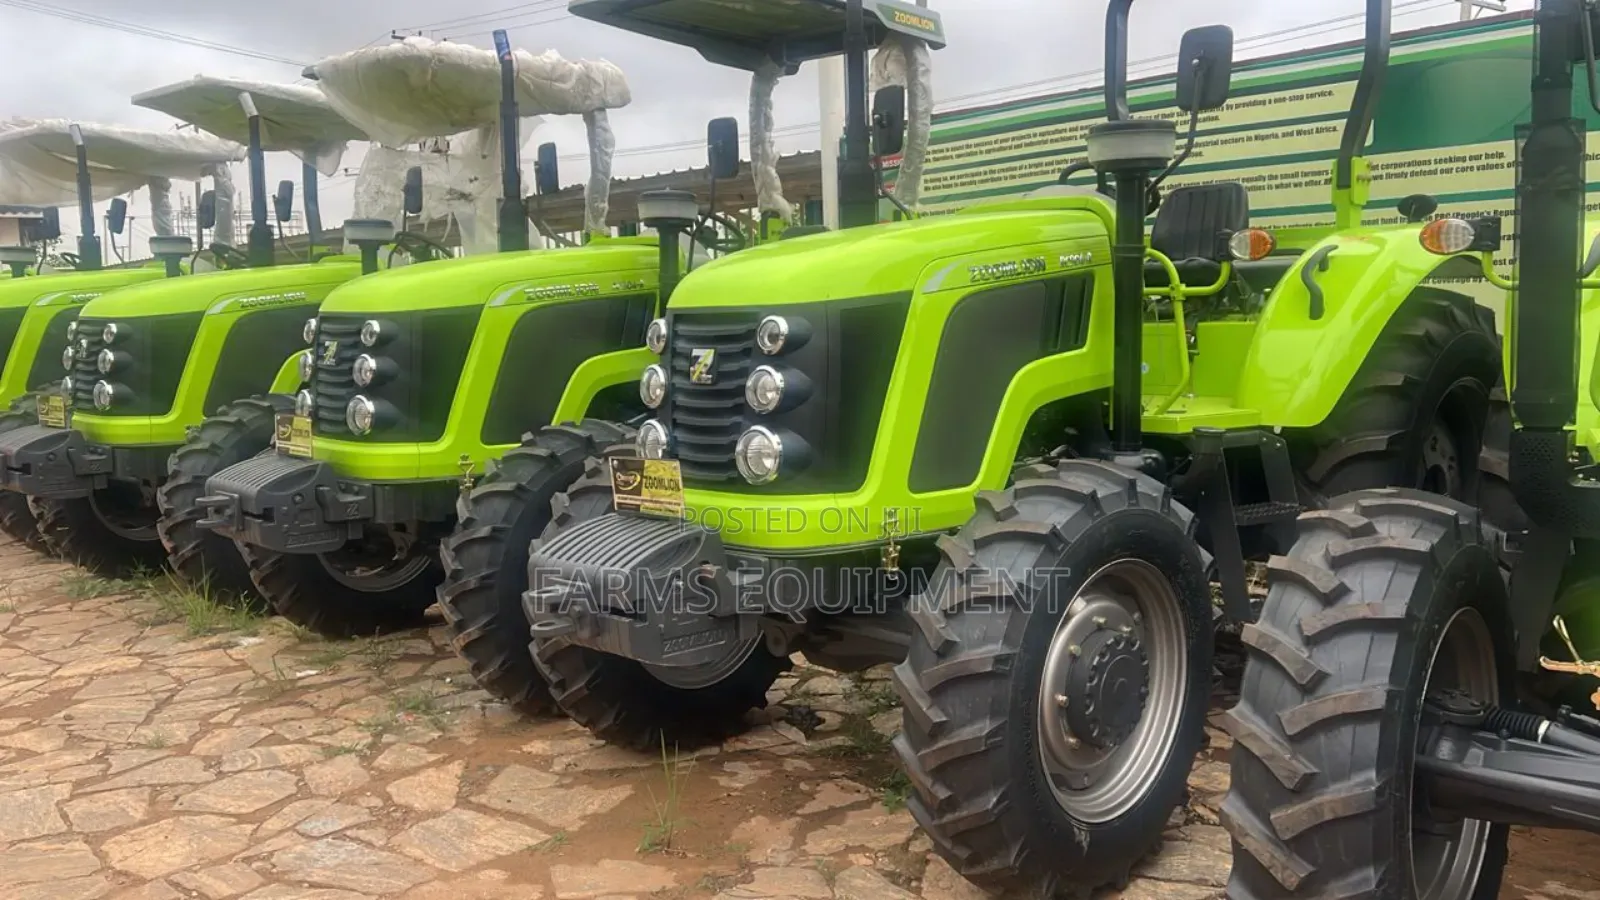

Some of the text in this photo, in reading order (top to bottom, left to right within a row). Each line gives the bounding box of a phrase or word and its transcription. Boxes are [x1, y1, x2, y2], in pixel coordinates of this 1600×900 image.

[1226, 102, 1234, 110] by
[1235, 98, 1266, 110] providing
[1274, 92, 1304, 104] one-stop
[1306, 89, 1334, 100] service.
[1220, 136, 1245, 146] sectors
[1254, 132, 1280, 142] Nigeria,
[1282, 130, 1294, 138] and
[1296, 128, 1314, 137] West
[1315, 125, 1338, 134] Africa.
[1381, 158, 1432, 170] corporations
[1434, 154, 1466, 165] seeking
[1484, 150, 1506, 160] help.
[1241, 174, 1266, 183] equally
[1280, 171, 1299, 180] small
[1300, 168, 1328, 178] farmers
[1385, 171, 1408, 180] firmly
[1410, 168, 1438, 178] defend
[1455, 166, 1475, 174] core
[1476, 162, 1505, 171] values
[1274, 182, 1292, 190] what
